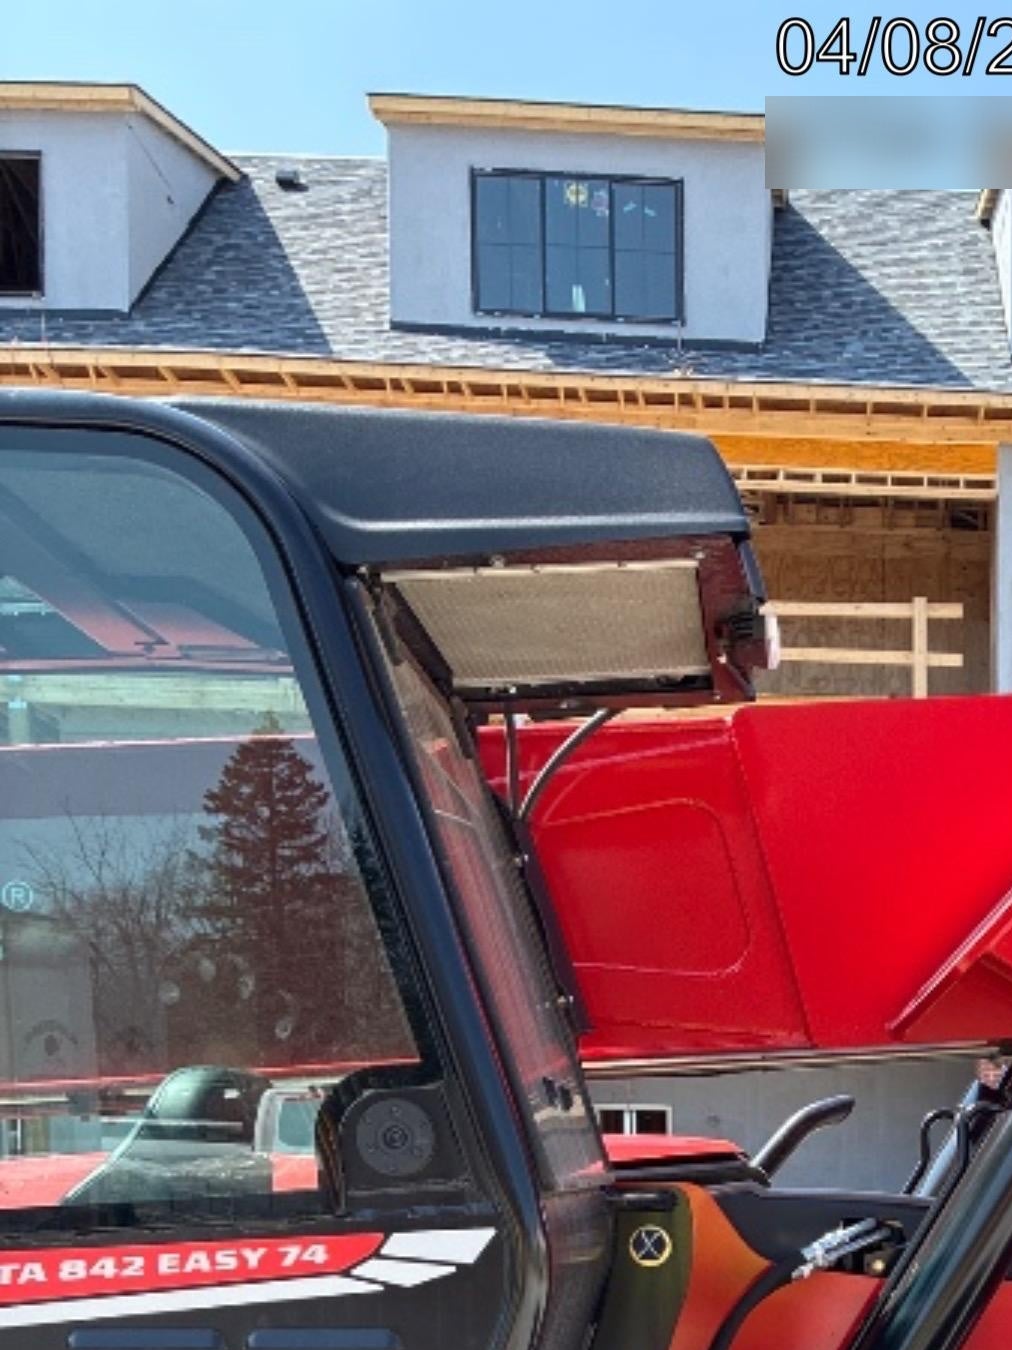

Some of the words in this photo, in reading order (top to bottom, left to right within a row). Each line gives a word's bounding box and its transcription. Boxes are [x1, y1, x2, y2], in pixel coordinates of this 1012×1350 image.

[58, 1256, 144, 1281] 842
[158, 1247, 267, 1274] EASY
[278, 1244, 328, 1266] 74
